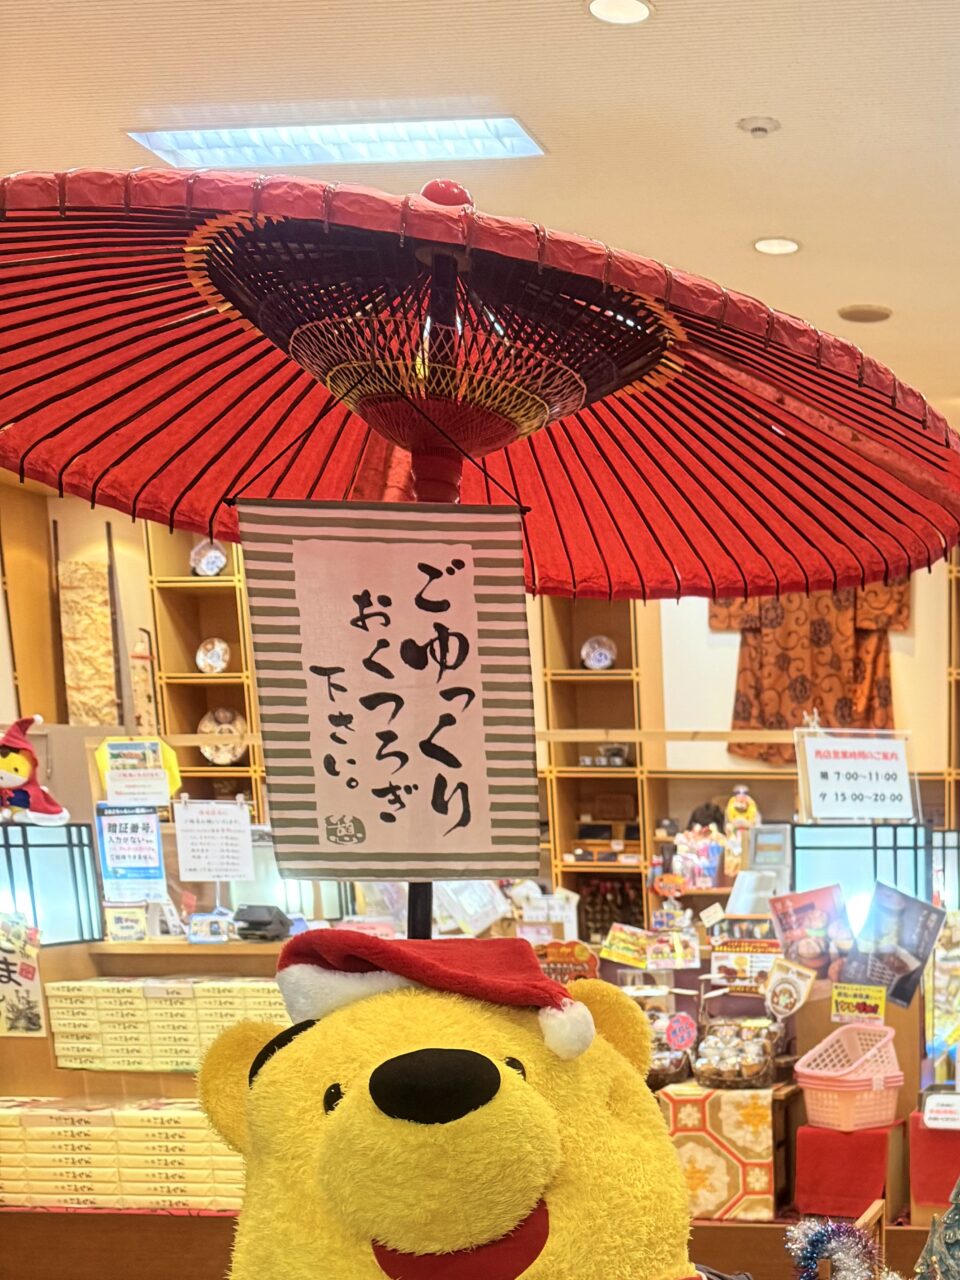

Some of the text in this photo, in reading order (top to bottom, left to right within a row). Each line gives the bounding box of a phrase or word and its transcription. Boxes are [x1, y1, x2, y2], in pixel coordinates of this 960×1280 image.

[309, 665, 360, 789] 下さい。
[350, 588, 419, 823] おくつろぎ
[400, 558, 476, 837] ごゆっくり
